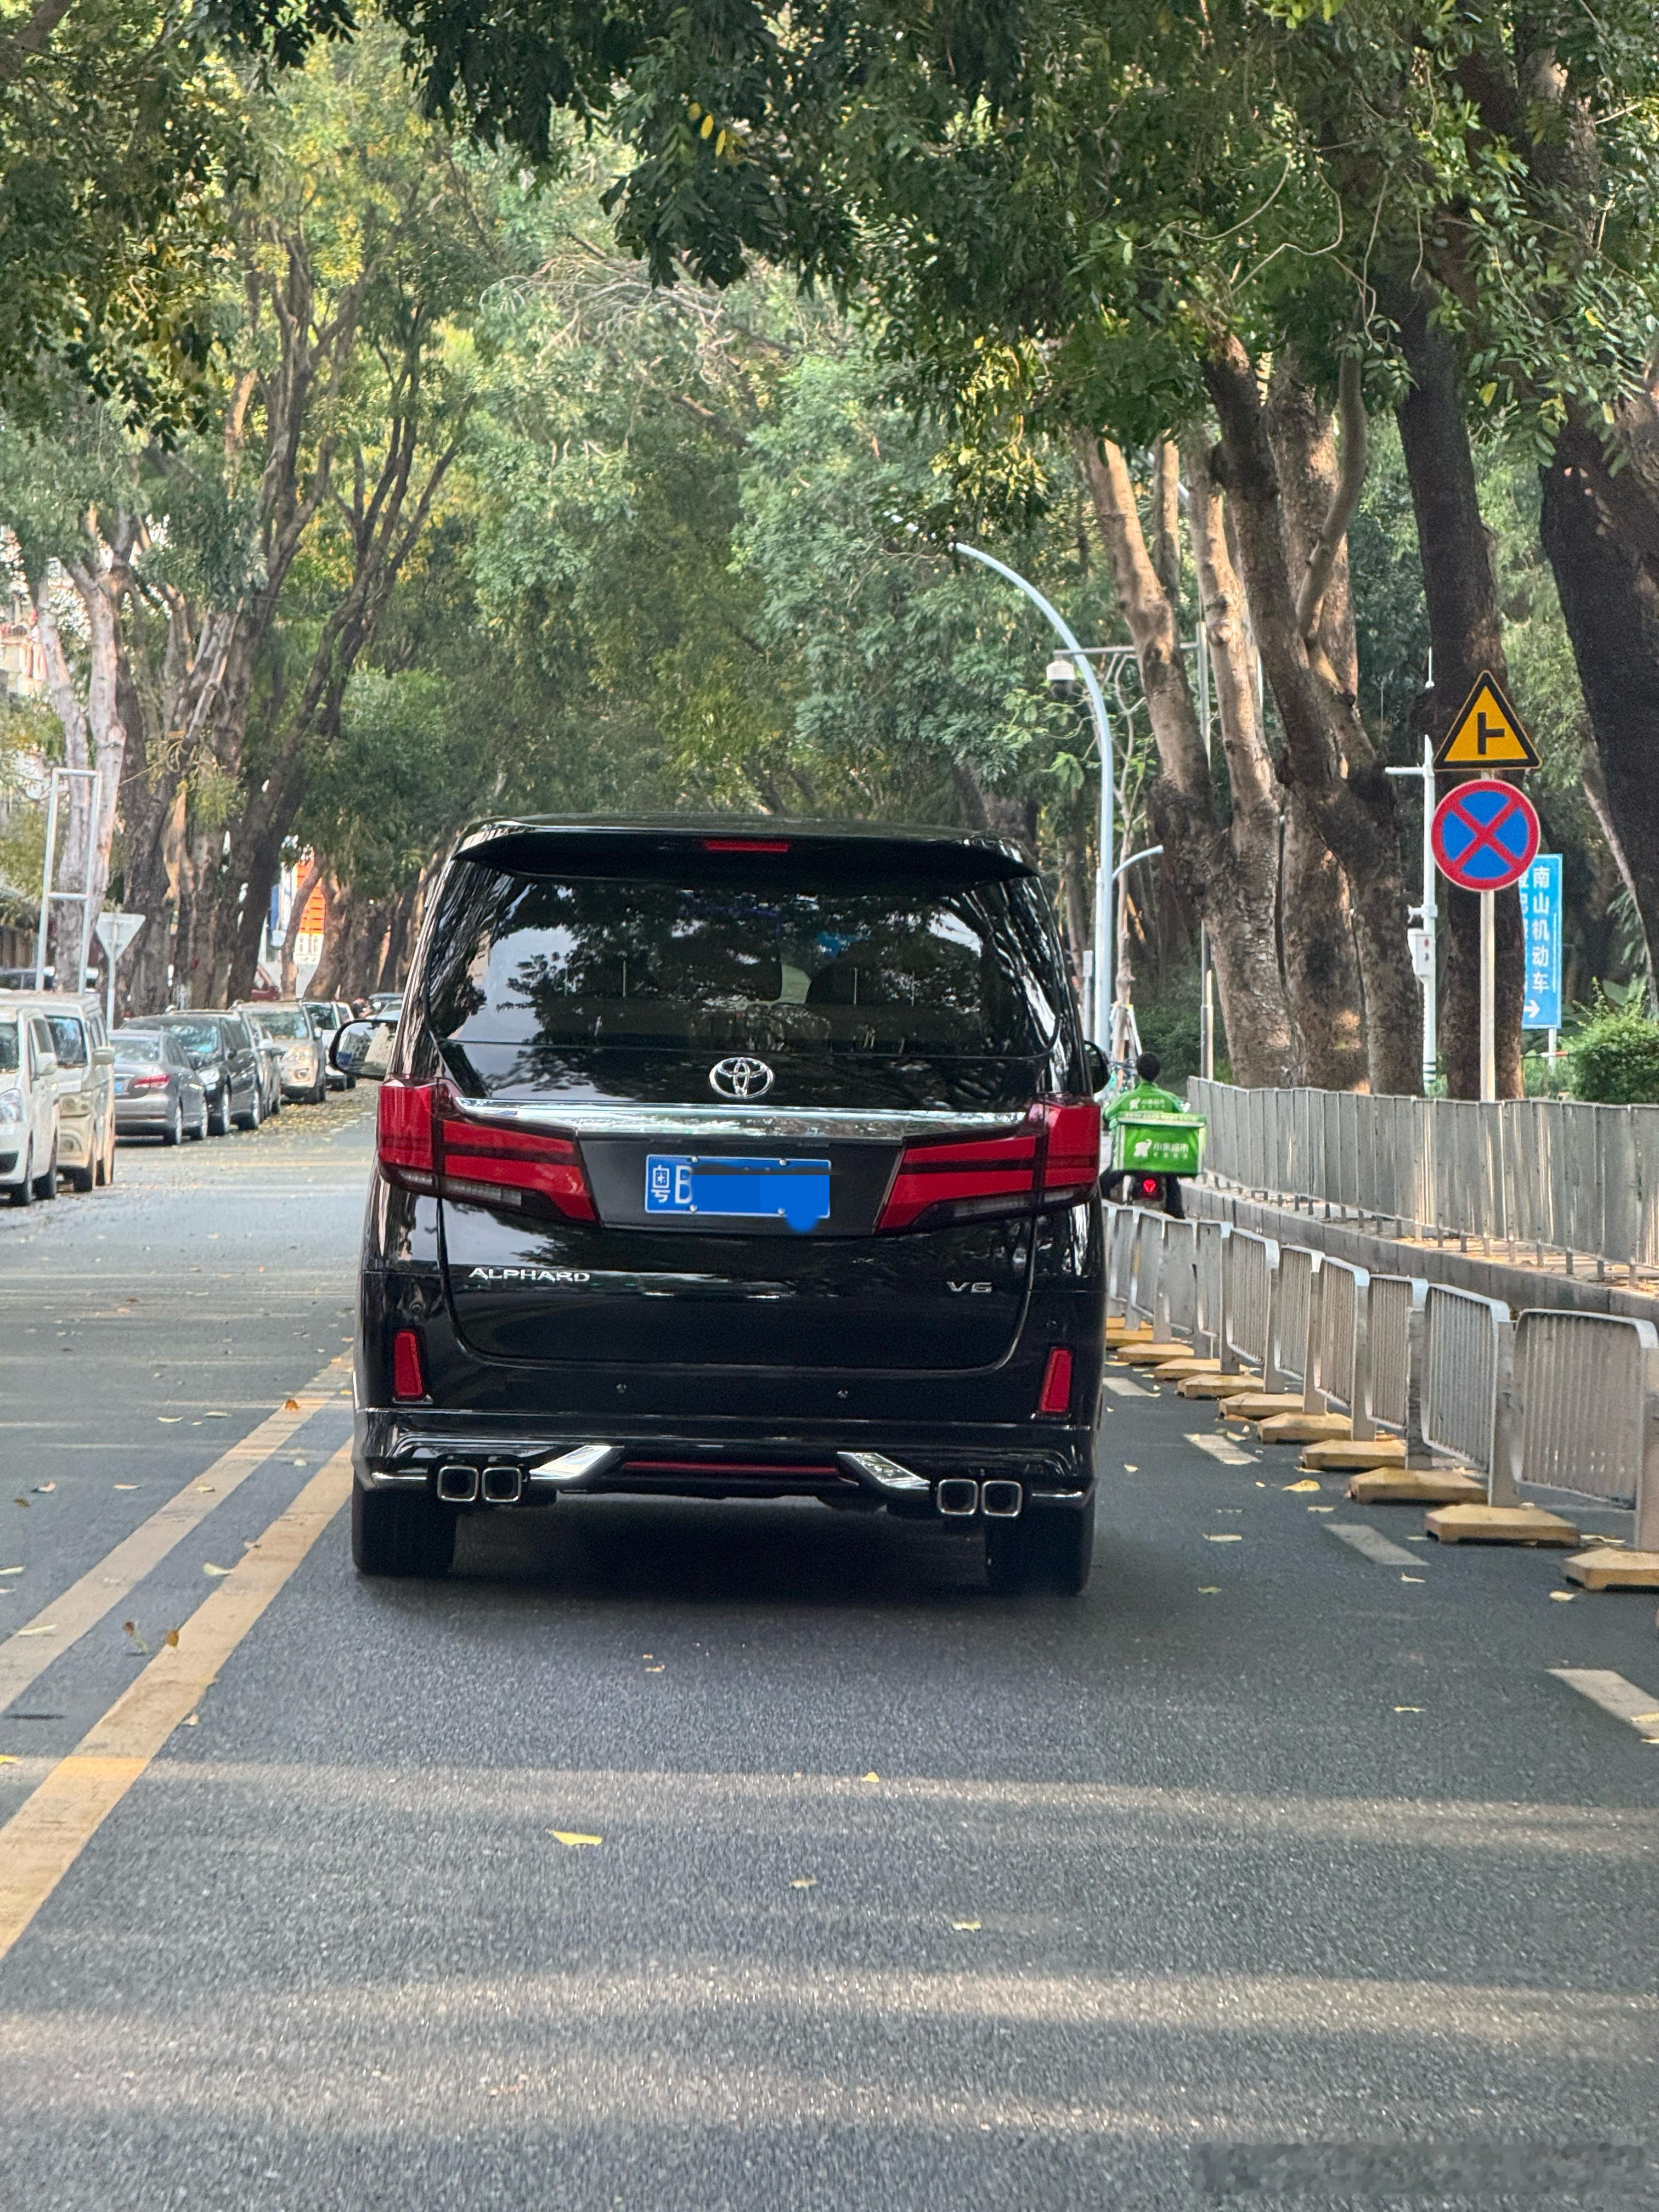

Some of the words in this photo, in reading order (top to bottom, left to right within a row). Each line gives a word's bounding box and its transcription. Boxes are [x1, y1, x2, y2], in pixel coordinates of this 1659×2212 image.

[1532, 865, 1550, 994] 南山机动车
[469, 1267, 590, 1283] ALPHARD
[946, 1280, 992, 1294] V6
